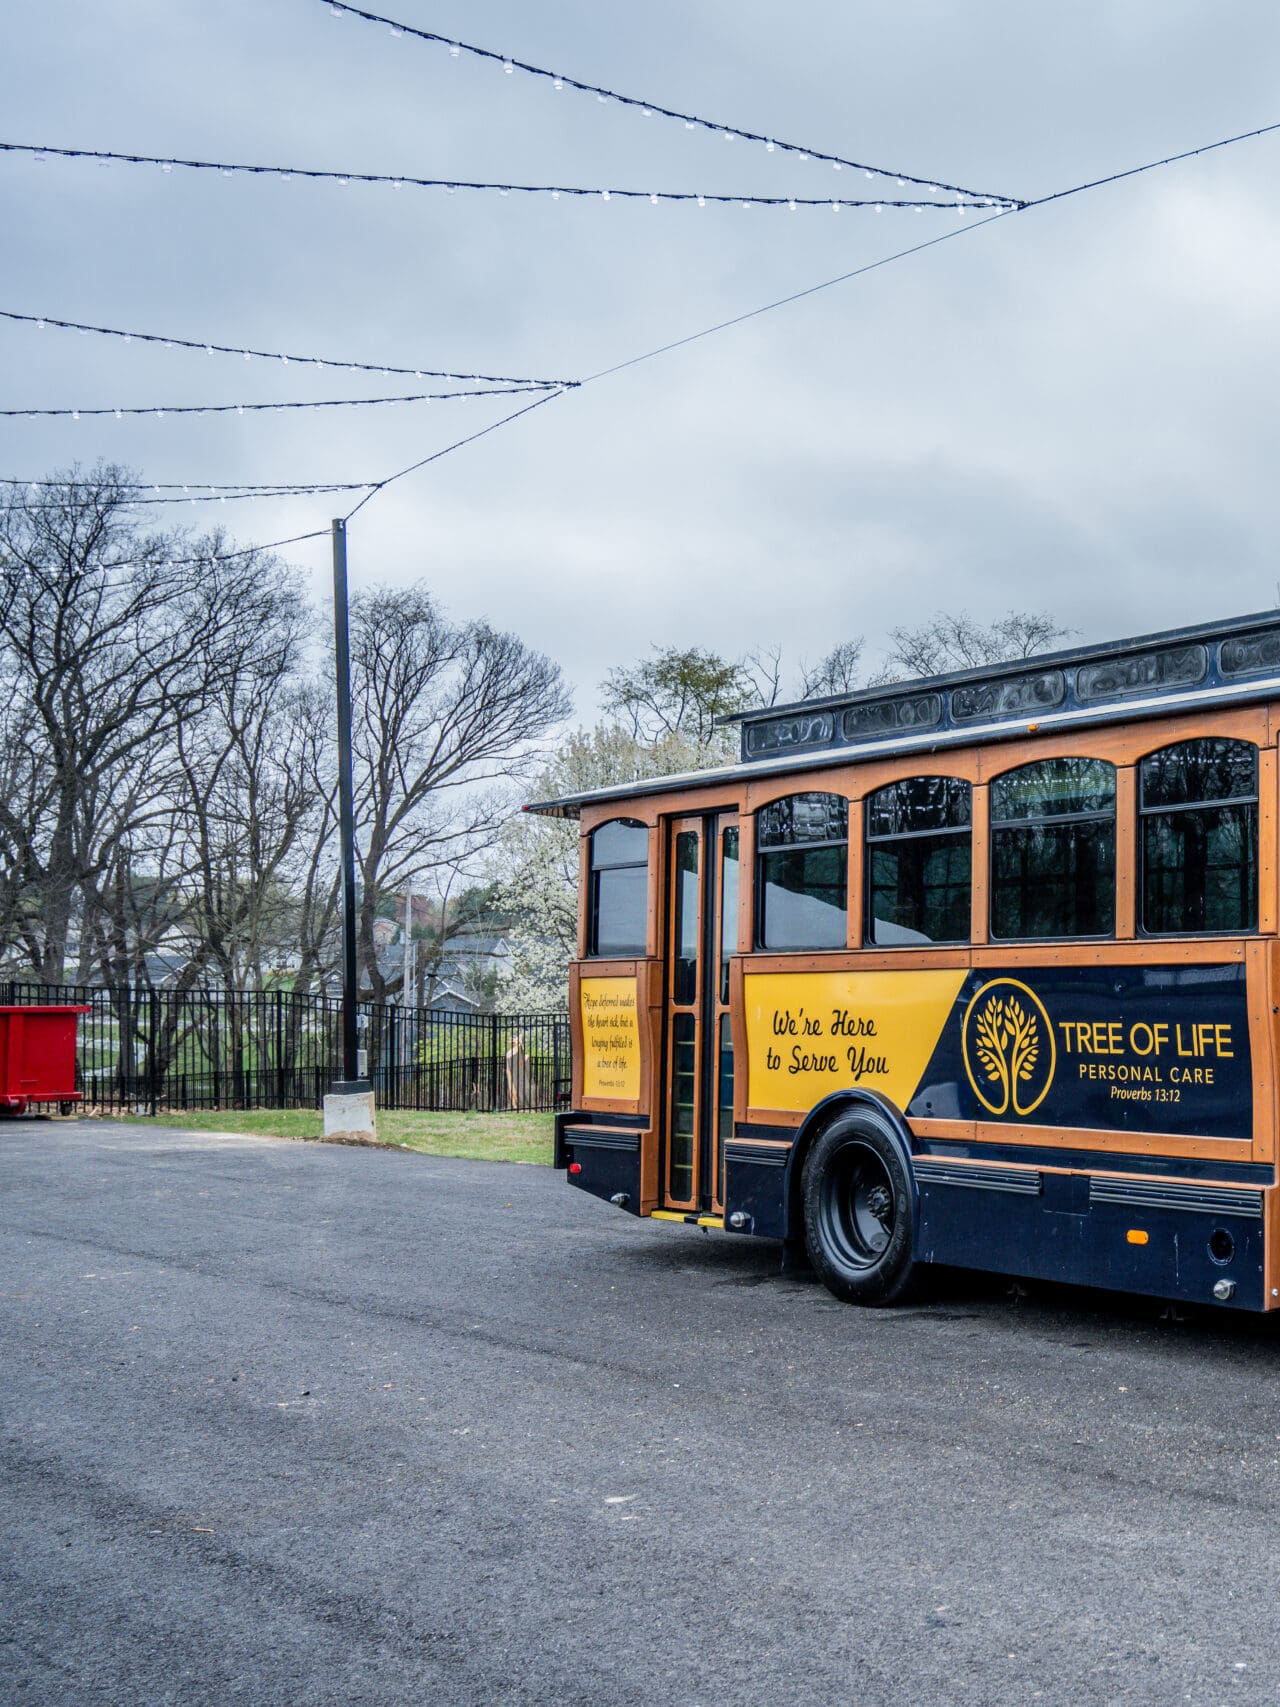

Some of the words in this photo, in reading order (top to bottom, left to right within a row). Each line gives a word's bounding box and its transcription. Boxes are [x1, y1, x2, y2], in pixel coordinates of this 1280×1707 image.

[619, 994, 635, 1006] makes
[587, 1014, 595, 1028] the
[596, 1014, 609, 1029] heart
[620, 1014, 629, 1028] but
[773, 1008, 823, 1036] We're
[830, 1009, 878, 1037] Here
[591, 1035, 609, 1052] longing
[609, 1034, 627, 1052] fulfilled
[628, 1039, 633, 1048] is
[1059, 1022, 1124, 1055] TREE
[1129, 1022, 1169, 1056] OF
[1176, 1023, 1234, 1058] LIFE
[601, 1056, 612, 1068] tree
[612, 1055, 619, 1072] of
[766, 1047, 781, 1071] to
[788, 1045, 839, 1075] Serve
[846, 1046, 890, 1082] You
[1079, 1064, 1162, 1083] PERSONAL
[1169, 1067, 1214, 1084] CARE
[1110, 1085, 1152, 1102] Proverbs
[1154, 1088, 1181, 1103] 13:12
